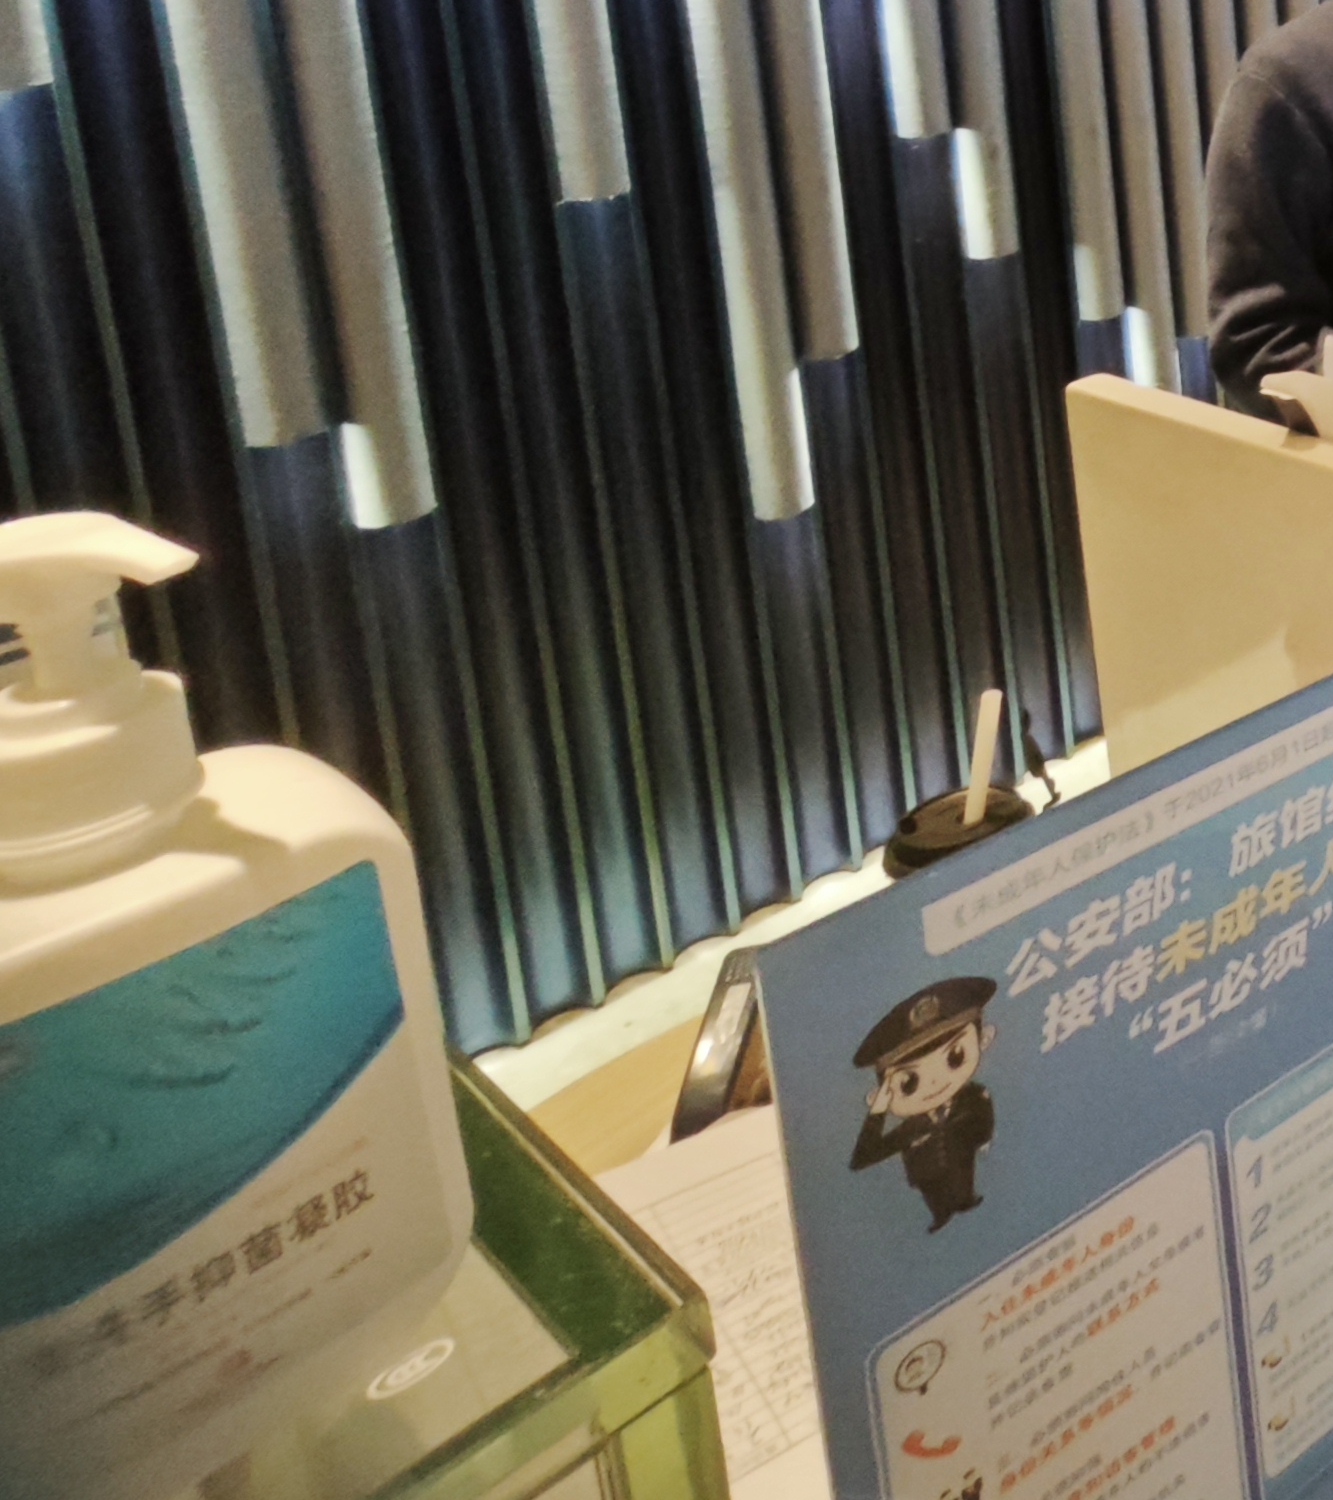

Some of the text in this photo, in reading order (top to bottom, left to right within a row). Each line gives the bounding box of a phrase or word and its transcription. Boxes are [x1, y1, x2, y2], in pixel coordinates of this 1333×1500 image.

[1246, 1154, 1264, 1188] 1
[1249, 1202, 1272, 1244] 2
[1252, 1255, 1275, 1292] 3
[1256, 1300, 1279, 1336] 4
